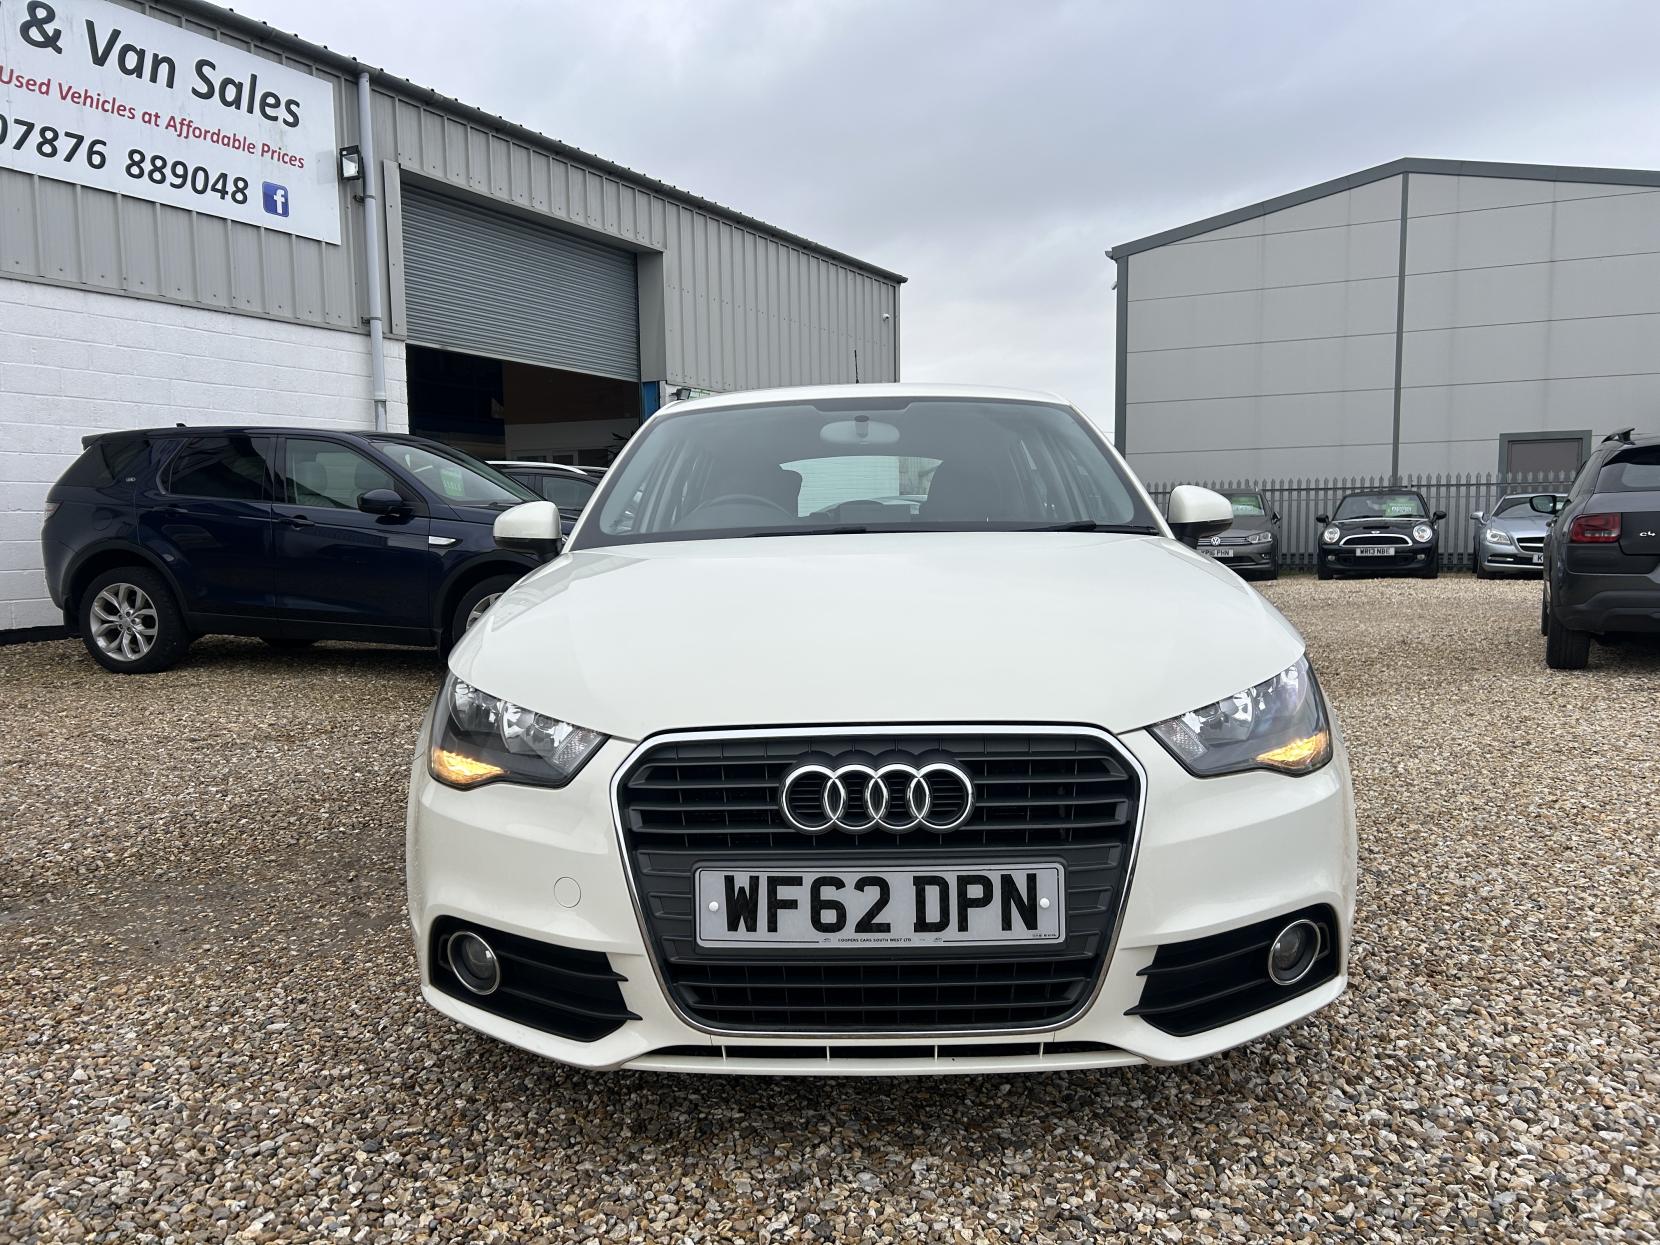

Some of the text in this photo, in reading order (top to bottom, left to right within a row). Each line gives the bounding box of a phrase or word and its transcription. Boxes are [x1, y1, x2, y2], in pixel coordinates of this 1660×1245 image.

[19, 0, 300, 128] & Van Sales
[0, 65, 305, 169] Used Vehicles at Affordable Prices
[125, 148, 249, 205] 889048
[723, 872, 1038, 934] WF62 DPN
